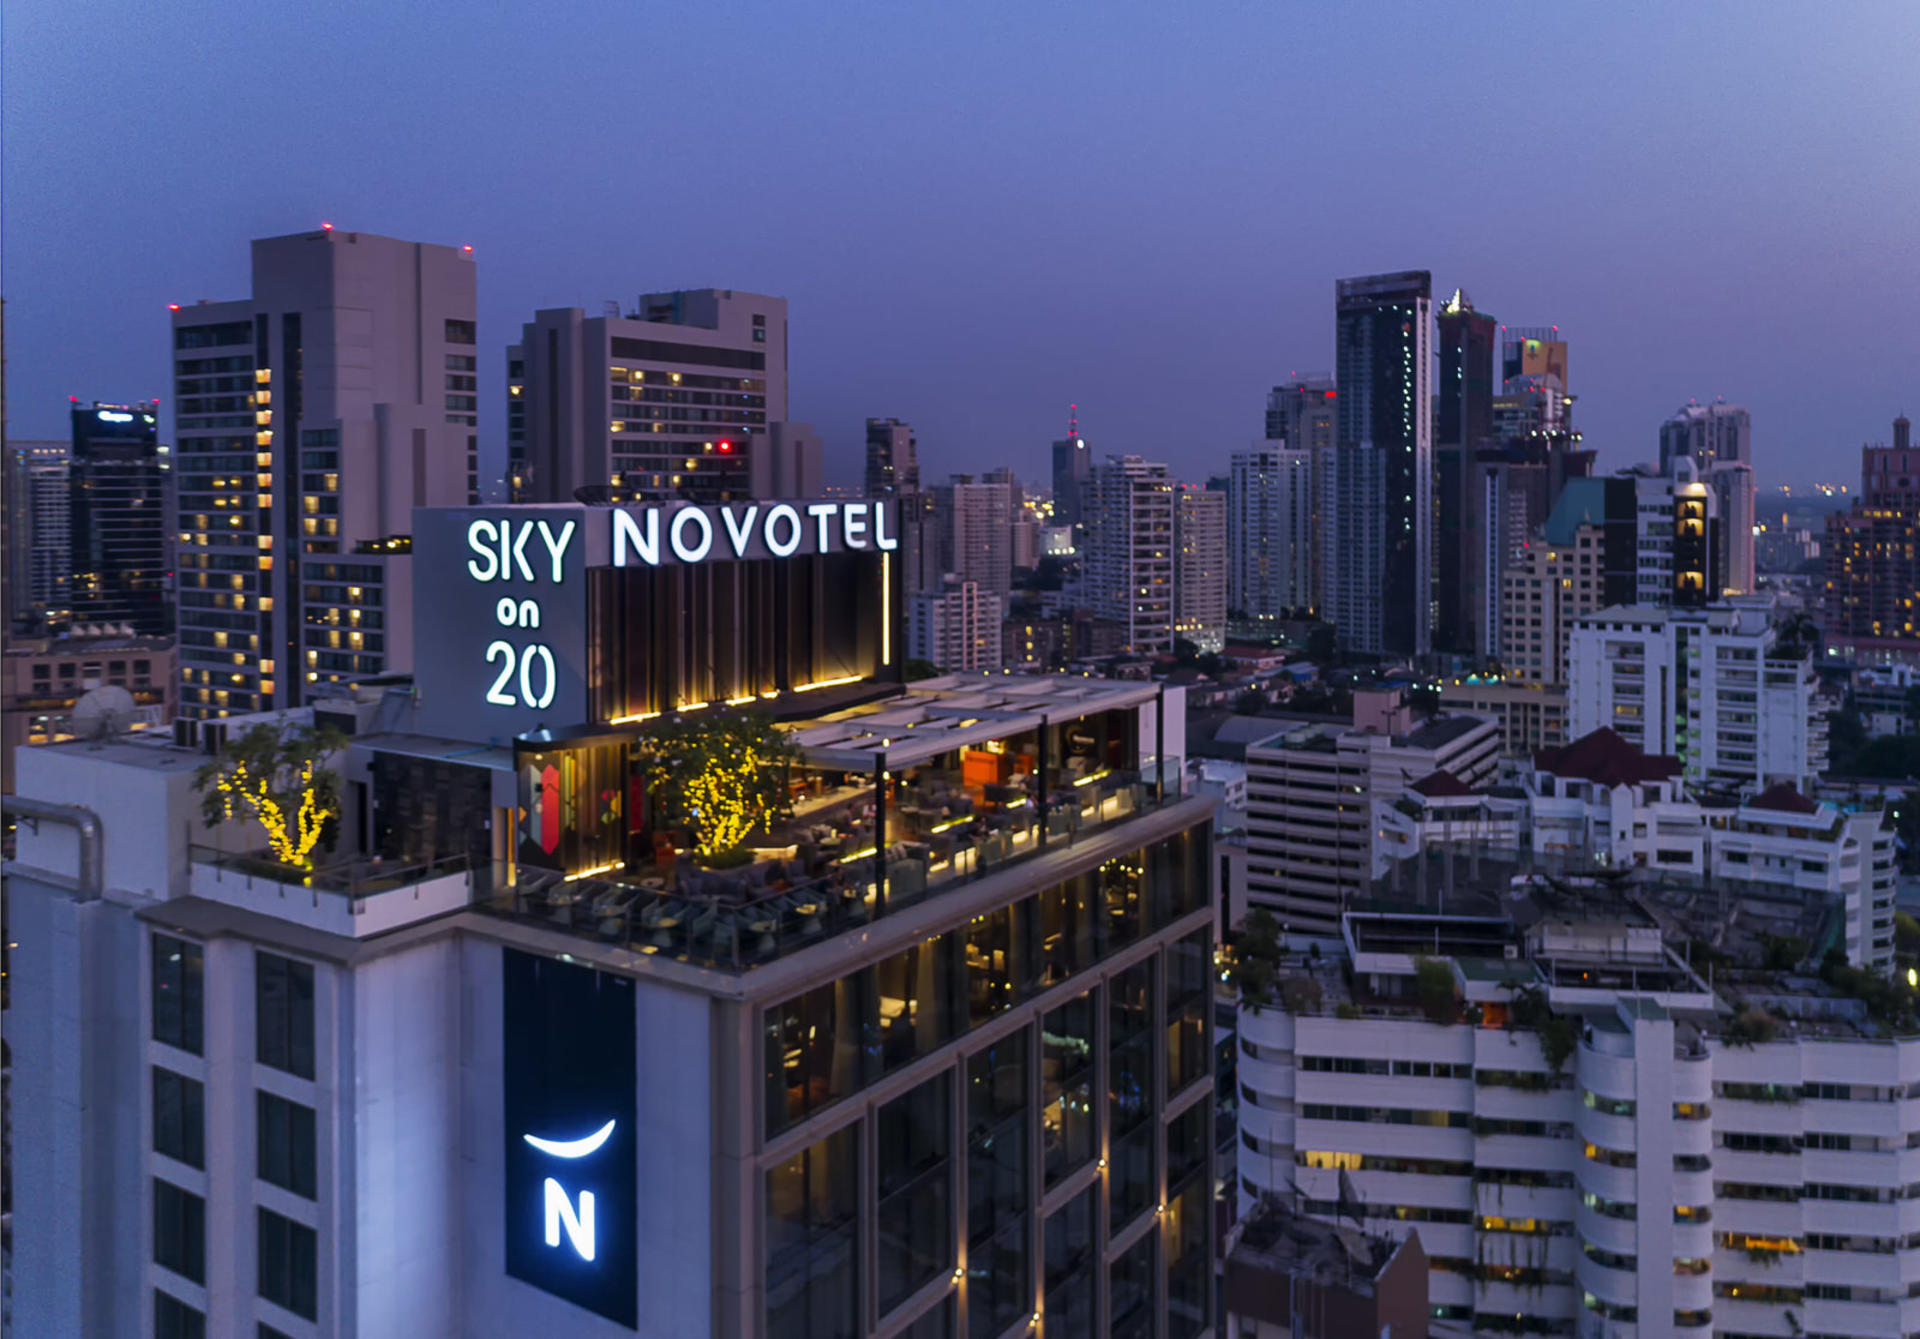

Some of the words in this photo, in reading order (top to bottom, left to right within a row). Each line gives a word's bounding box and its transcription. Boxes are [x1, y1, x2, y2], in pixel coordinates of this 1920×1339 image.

[468, 520, 575, 583] SKY
[613, 502, 898, 567] NOVOTEL
[497, 597, 540, 628] on
[486, 640, 556, 709] 20
[544, 1177, 595, 1262] N
